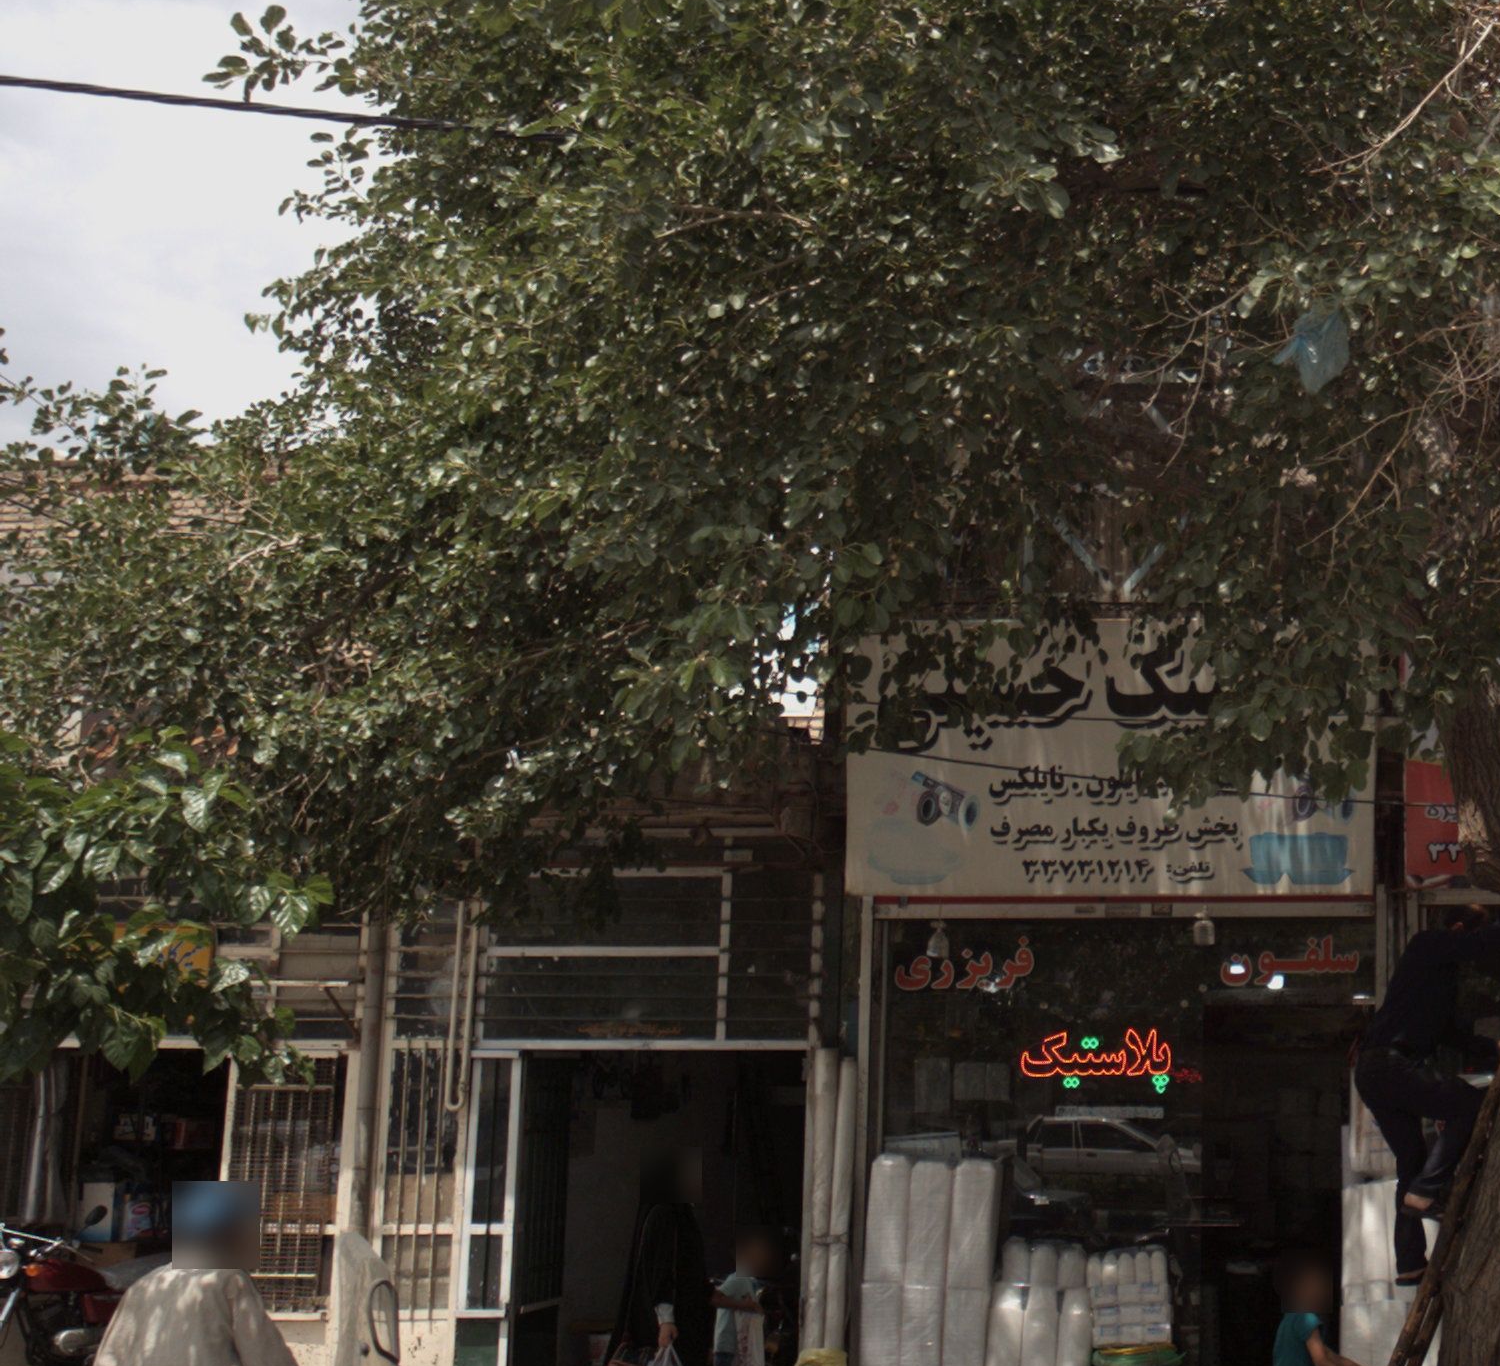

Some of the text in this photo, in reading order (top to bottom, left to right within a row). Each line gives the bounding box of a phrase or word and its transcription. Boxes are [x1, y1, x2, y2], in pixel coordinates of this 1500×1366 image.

[990, 766, 1066, 800] نایلکس
[1086, 770, 1147, 801] ایلون
[990, 815, 1054, 840] مصرف
[1061, 817, 1109, 843] یکبار
[1186, 816, 1240, 844] پخش
[1166, 861, 1211, 877] تلفن:
[895, 936, 1359, 990] سلفون فریزری
[1021, 1028, 1172, 1093] پلاستیک
